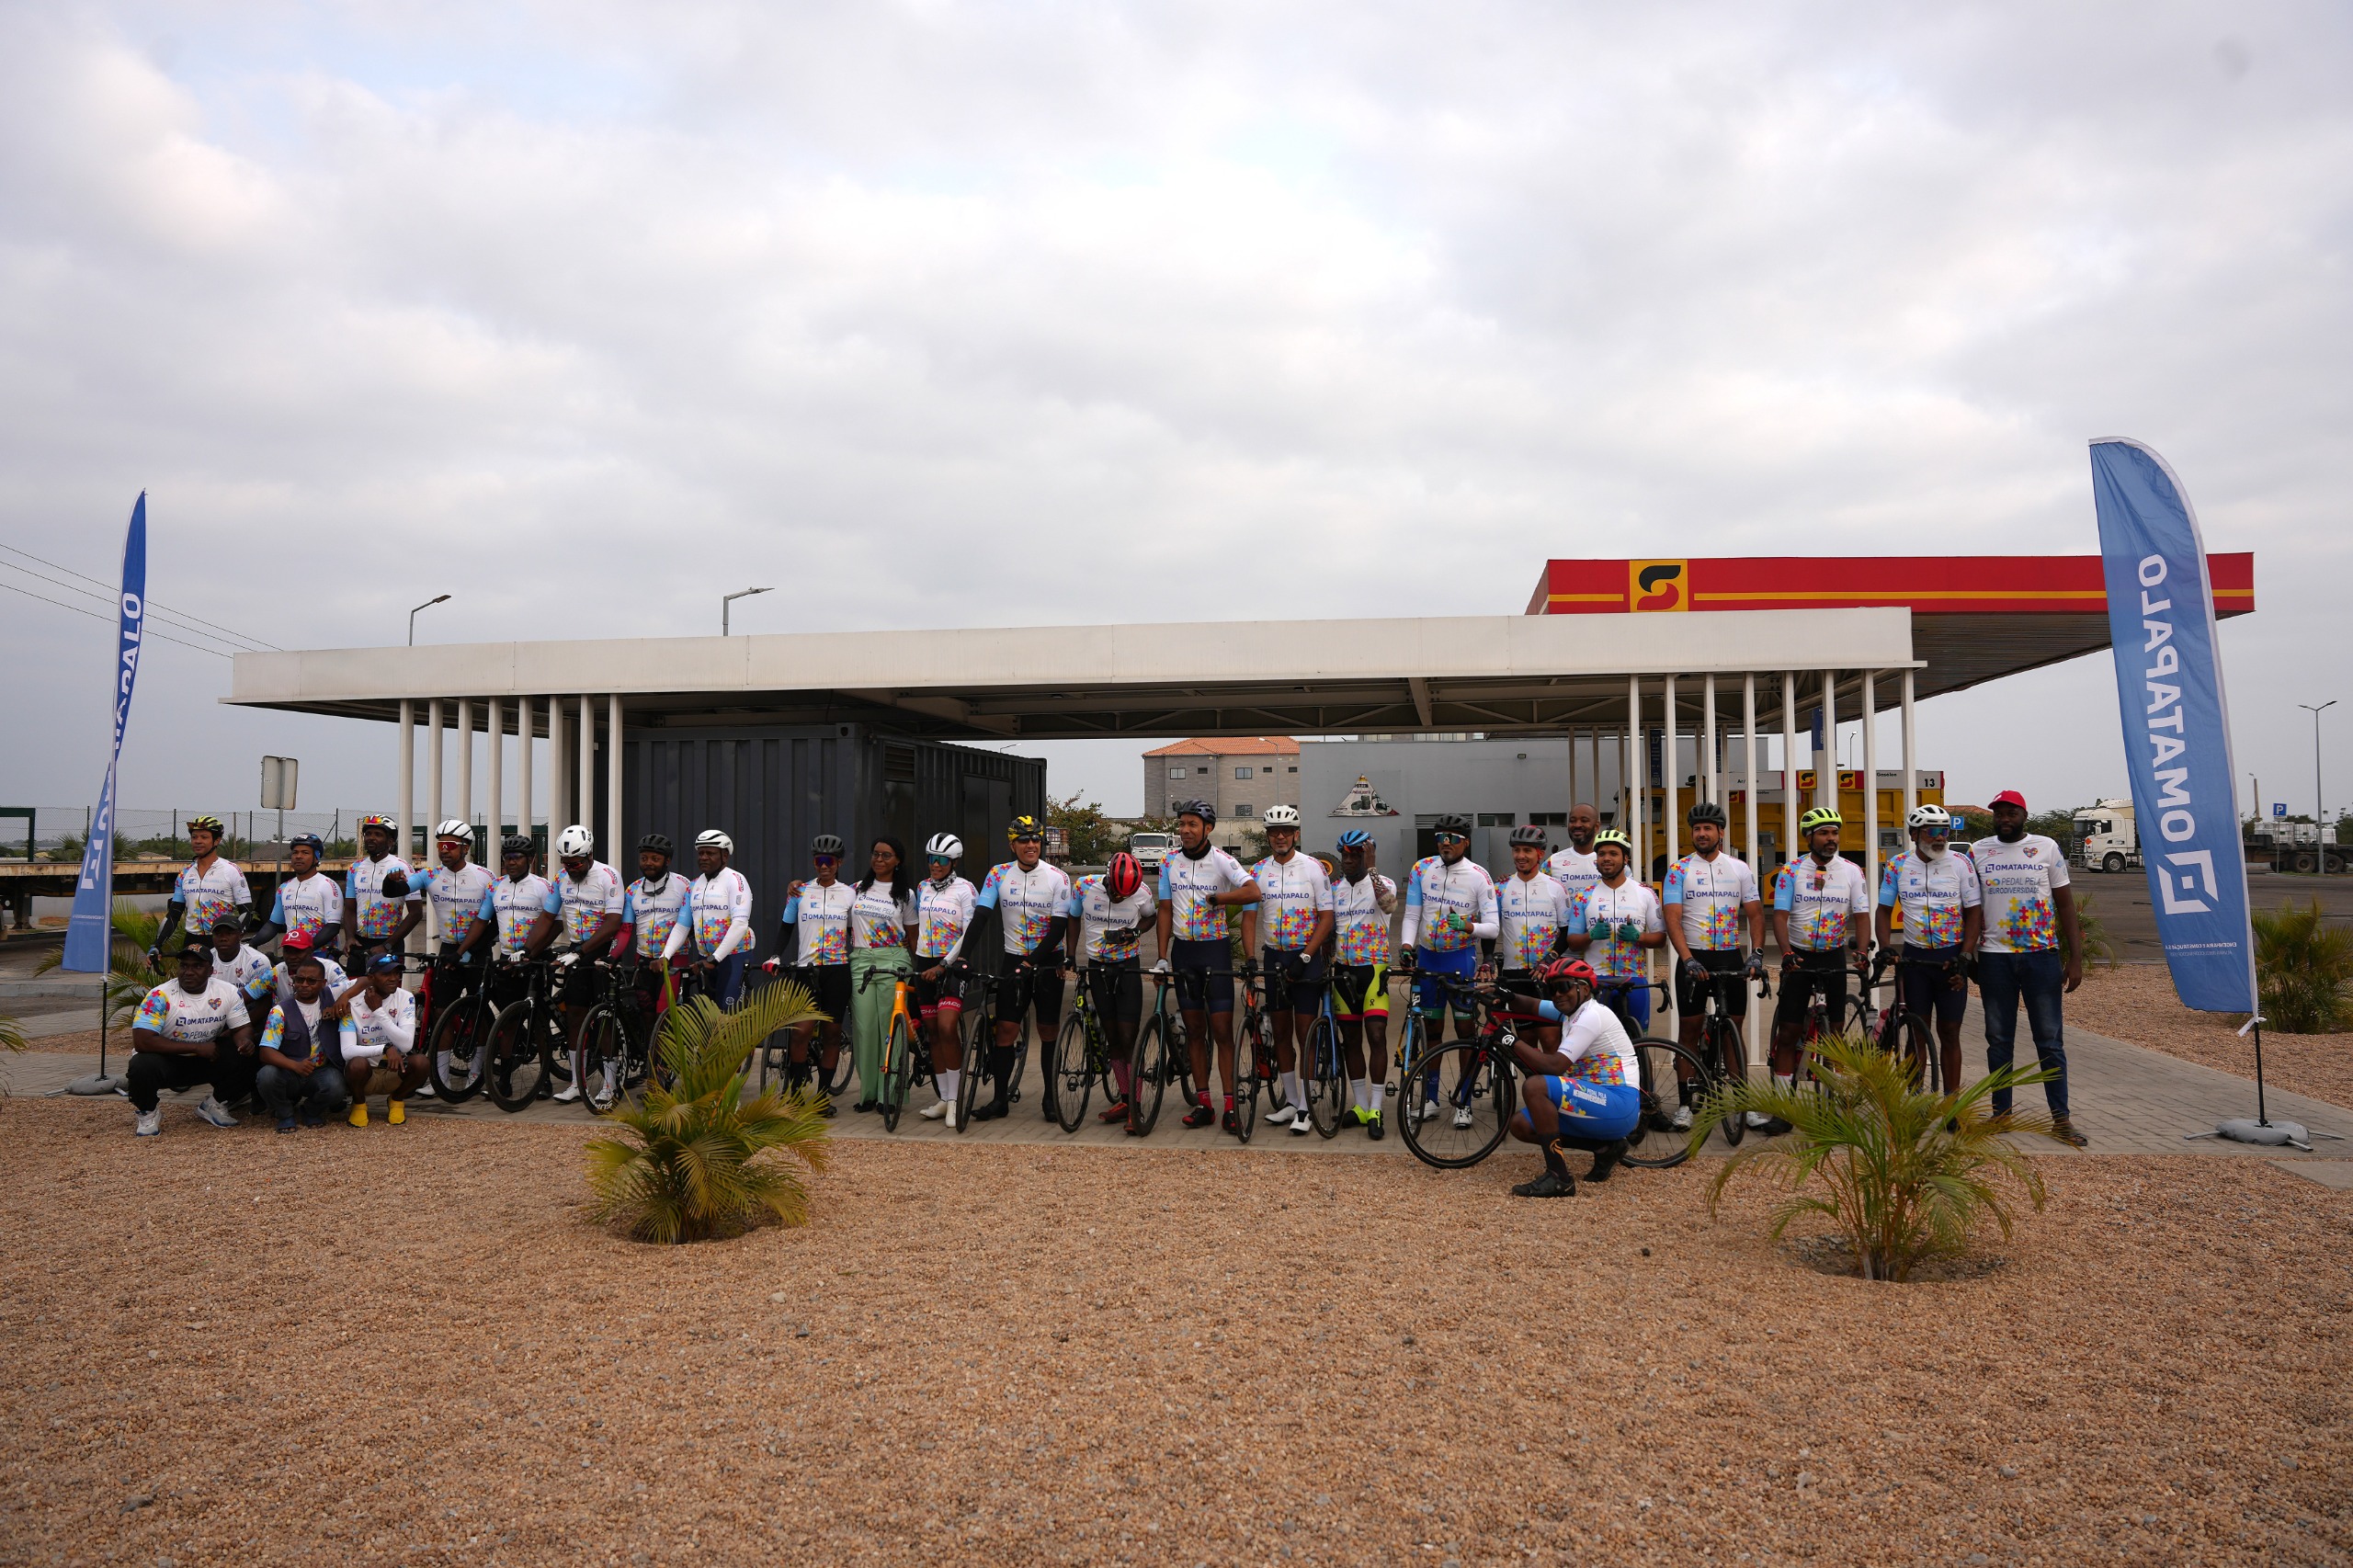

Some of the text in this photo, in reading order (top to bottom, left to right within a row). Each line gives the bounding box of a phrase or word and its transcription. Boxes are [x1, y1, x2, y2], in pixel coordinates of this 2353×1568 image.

[1925, 778, 1936, 788] 13
[2276, 804, 2284, 814] P
[1953, 817, 1961, 825] P
[2001, 877, 2022, 886] PEDAL
[1803, 895, 1848, 904] OMATAPALO
[1908, 891, 1958, 899] OMATAPALO
[866, 897, 893, 905] OMATAPA
[1427, 896, 1471, 908] OMATAPALO
[640, 907, 680, 915] OMATAPALO
[1336, 908, 1375, 918] OMATAPALO
[188, 1015, 227, 1026] OMATAPALO
